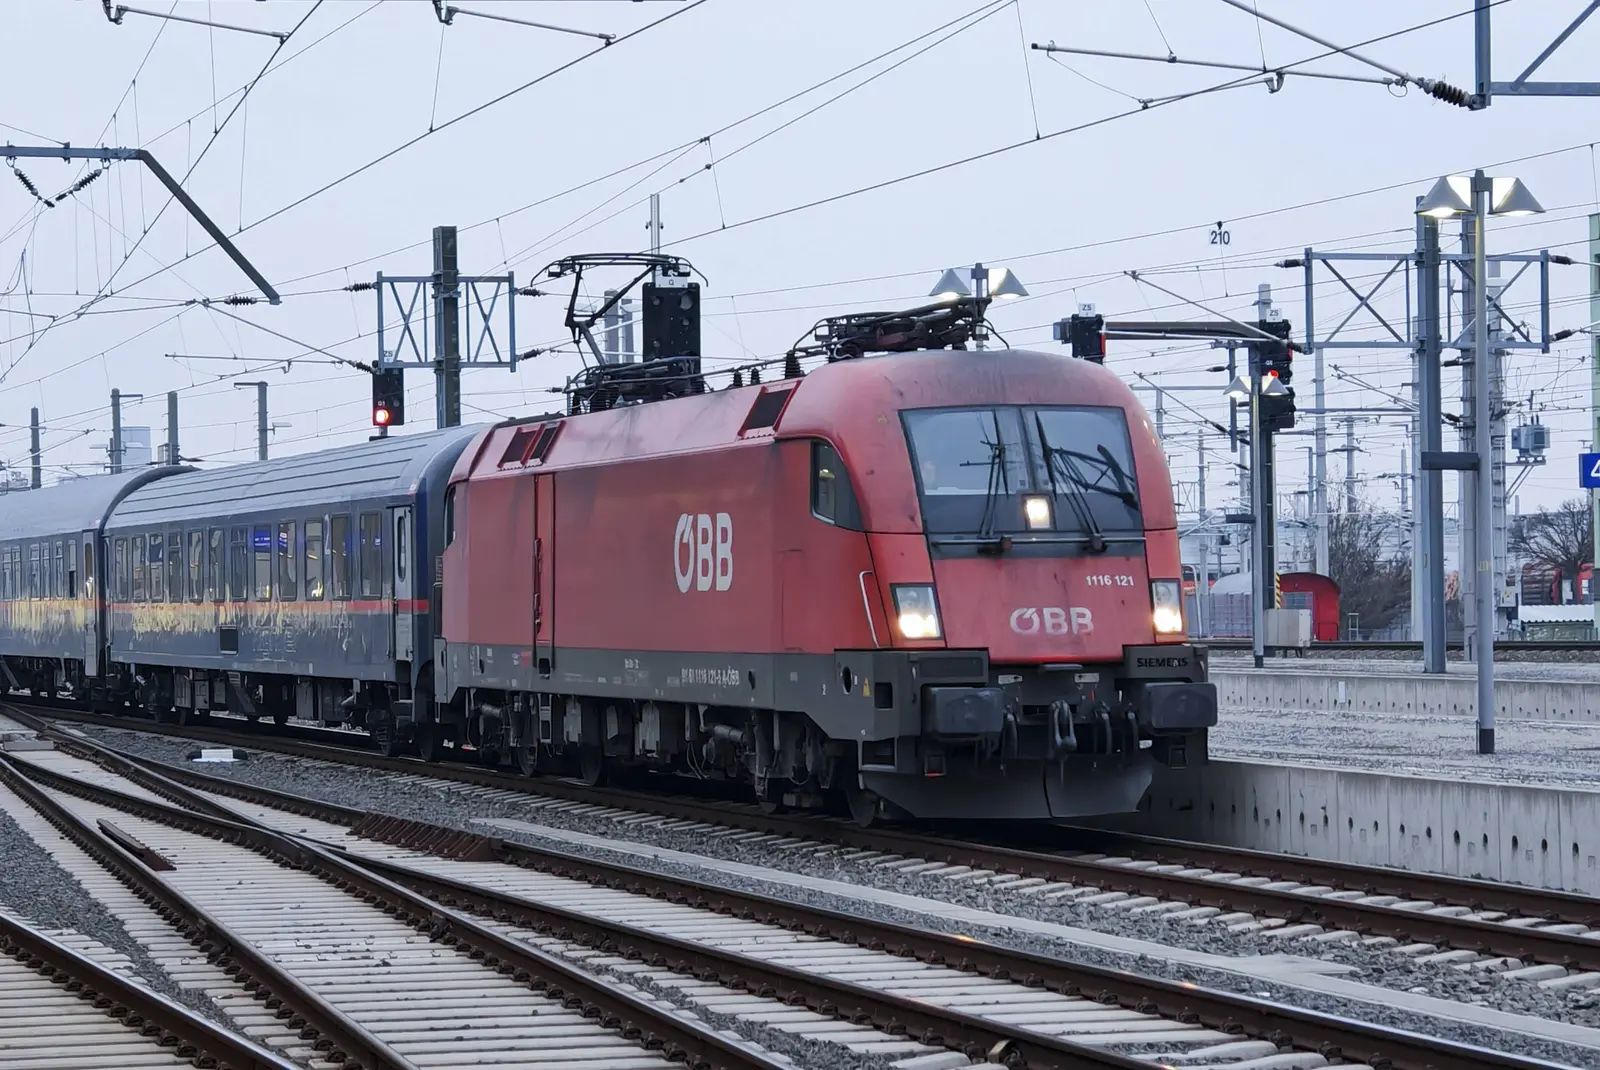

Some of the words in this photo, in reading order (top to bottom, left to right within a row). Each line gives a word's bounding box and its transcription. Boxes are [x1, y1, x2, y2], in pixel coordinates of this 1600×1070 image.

[1210, 230, 1231, 245] 210
[673, 512, 733, 594] ÖBB
[1085, 575, 1112, 586] 1116
[1114, 575, 1134, 586] 121
[1009, 606, 1094, 636] ÖBB
[1136, 657, 1189, 668] SIEMENS
